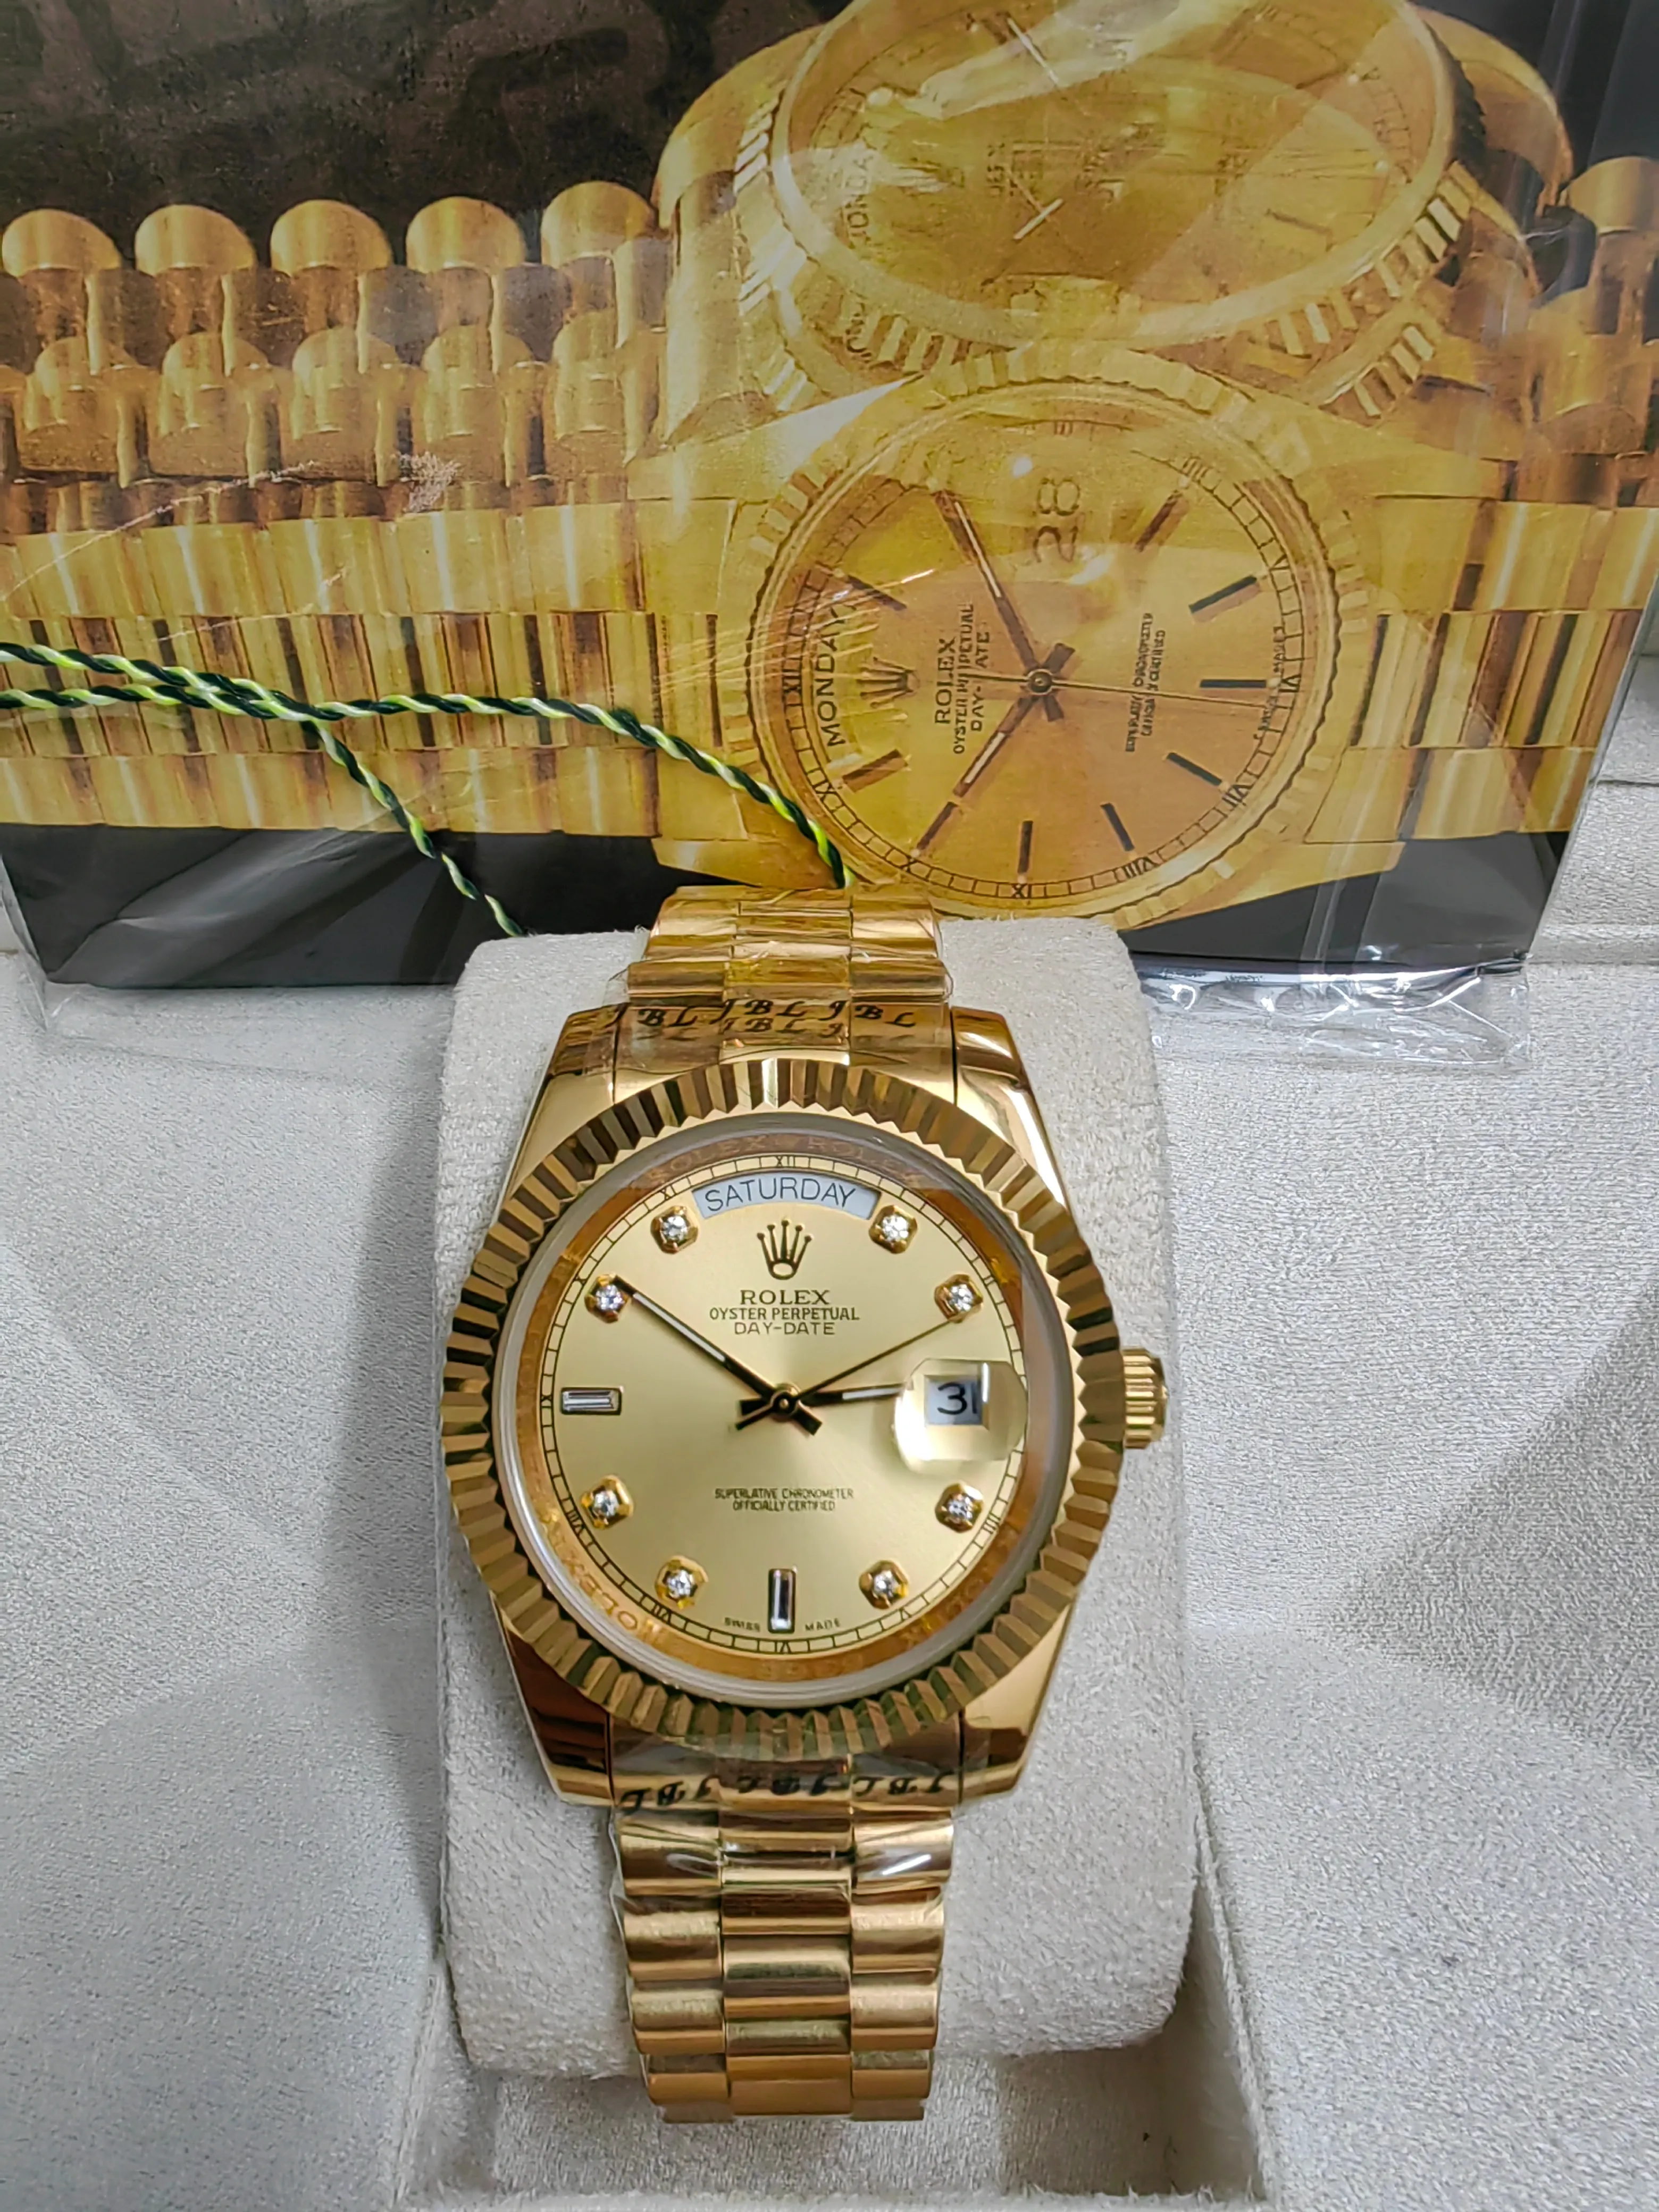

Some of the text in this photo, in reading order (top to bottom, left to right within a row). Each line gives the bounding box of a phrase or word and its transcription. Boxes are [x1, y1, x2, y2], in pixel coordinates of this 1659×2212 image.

[815, 606, 845, 747] MONDAY
[935, 636, 956, 724] ROLEX
[971, 631, 990, 732] DAY-ATE
[704, 1176, 856, 1212] SATURDAY
[740, 1289, 831, 1305] ROLEX
[709, 1307, 860, 1320] OYSTER PERPETUAL
[734, 1322, 836, 1335] DAY-DATE
[936, 1381, 978, 1415] 31
[715, 1487, 854, 1500] SUPERLATIVE CHRONOMETER
[732, 1500, 836, 1512] OFFICIALLY CERTIFIED
[724, 1616, 841, 1632] SWISS MADE
